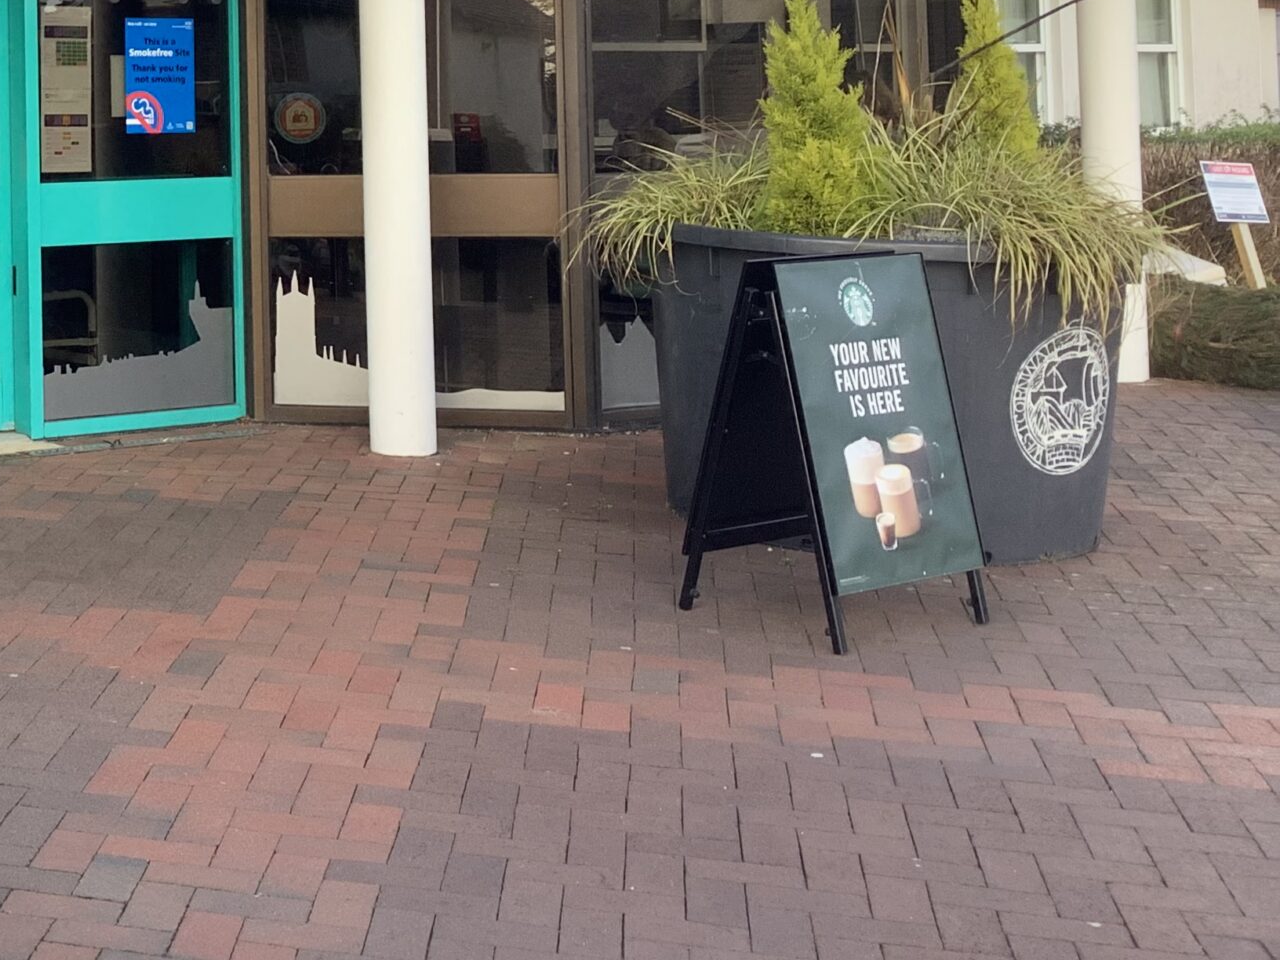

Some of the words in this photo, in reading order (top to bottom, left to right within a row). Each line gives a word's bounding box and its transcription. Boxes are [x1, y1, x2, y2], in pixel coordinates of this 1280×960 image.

[129, 48, 173, 57] Smokefree
[132, 64, 156, 72] Thank
[176, 64, 188, 72] for
[151, 76, 186, 84] smoking
[829, 341, 869, 366] YOUR
[872, 338, 901, 361] NEW
[834, 363, 909, 392] FAVOURITE
[850, 394, 865, 417] IS
[867, 390, 904, 415] HERE
